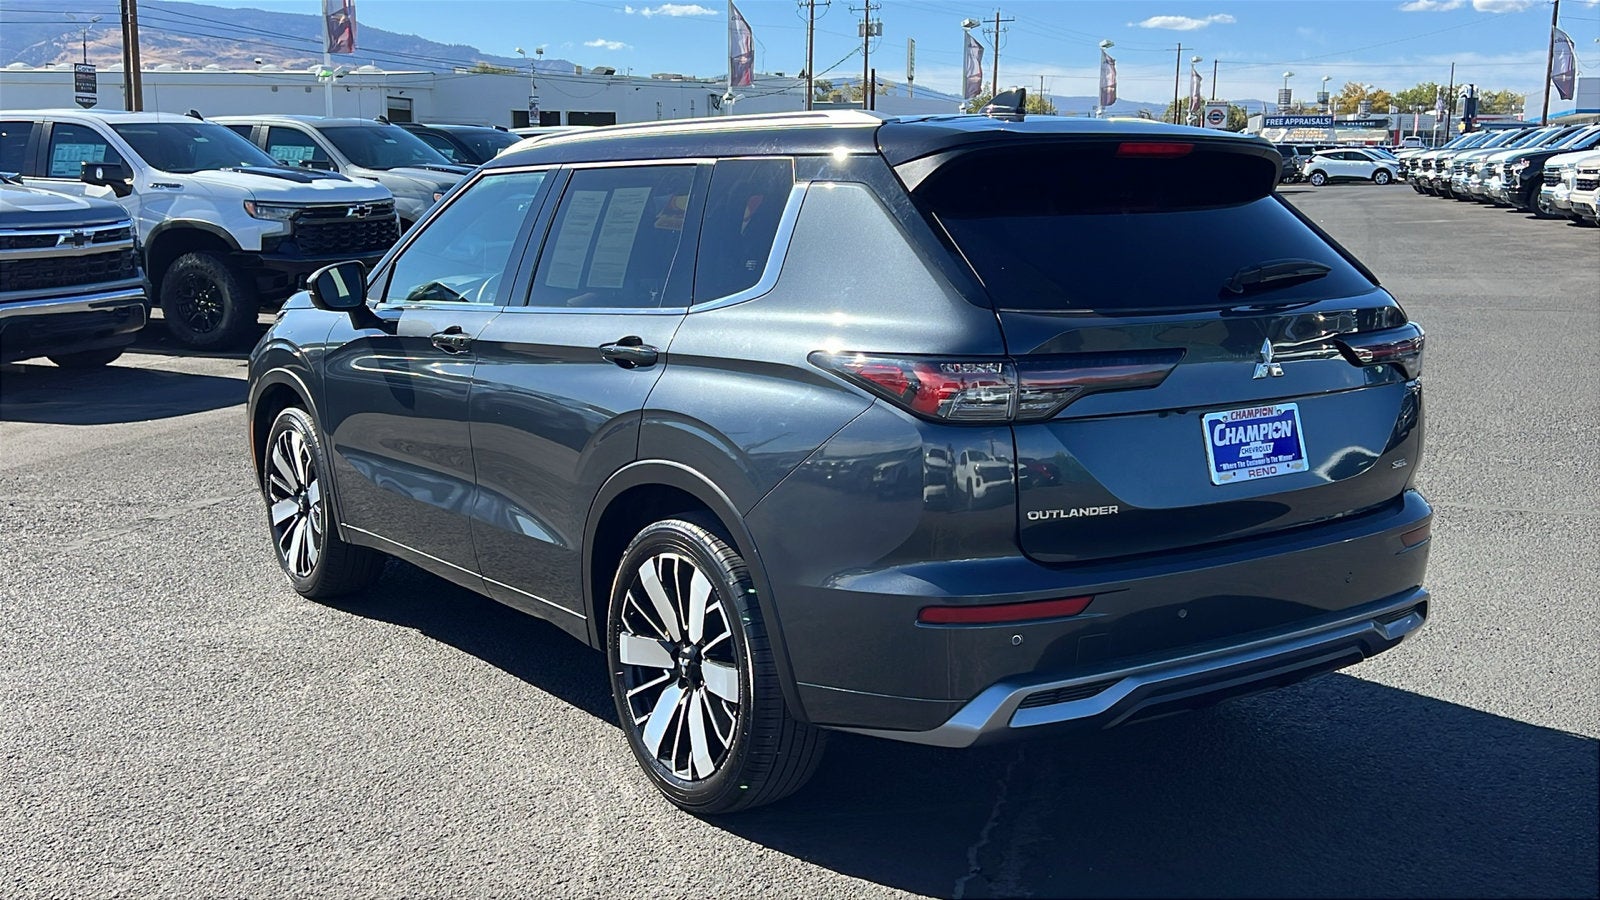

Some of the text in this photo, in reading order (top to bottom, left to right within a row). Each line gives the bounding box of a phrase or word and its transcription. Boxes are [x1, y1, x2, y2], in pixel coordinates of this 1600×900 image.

[1266, 117, 1332, 126] FREE APPRAISALS!
[1230, 407, 1274, 420] CHAMPION
[1213, 420, 1292, 446] CHAMPION
[1241, 445, 1272, 454] CHEVROLET
[1248, 466, 1277, 478] RENO
[1027, 505, 1119, 520] OUTLANDER
